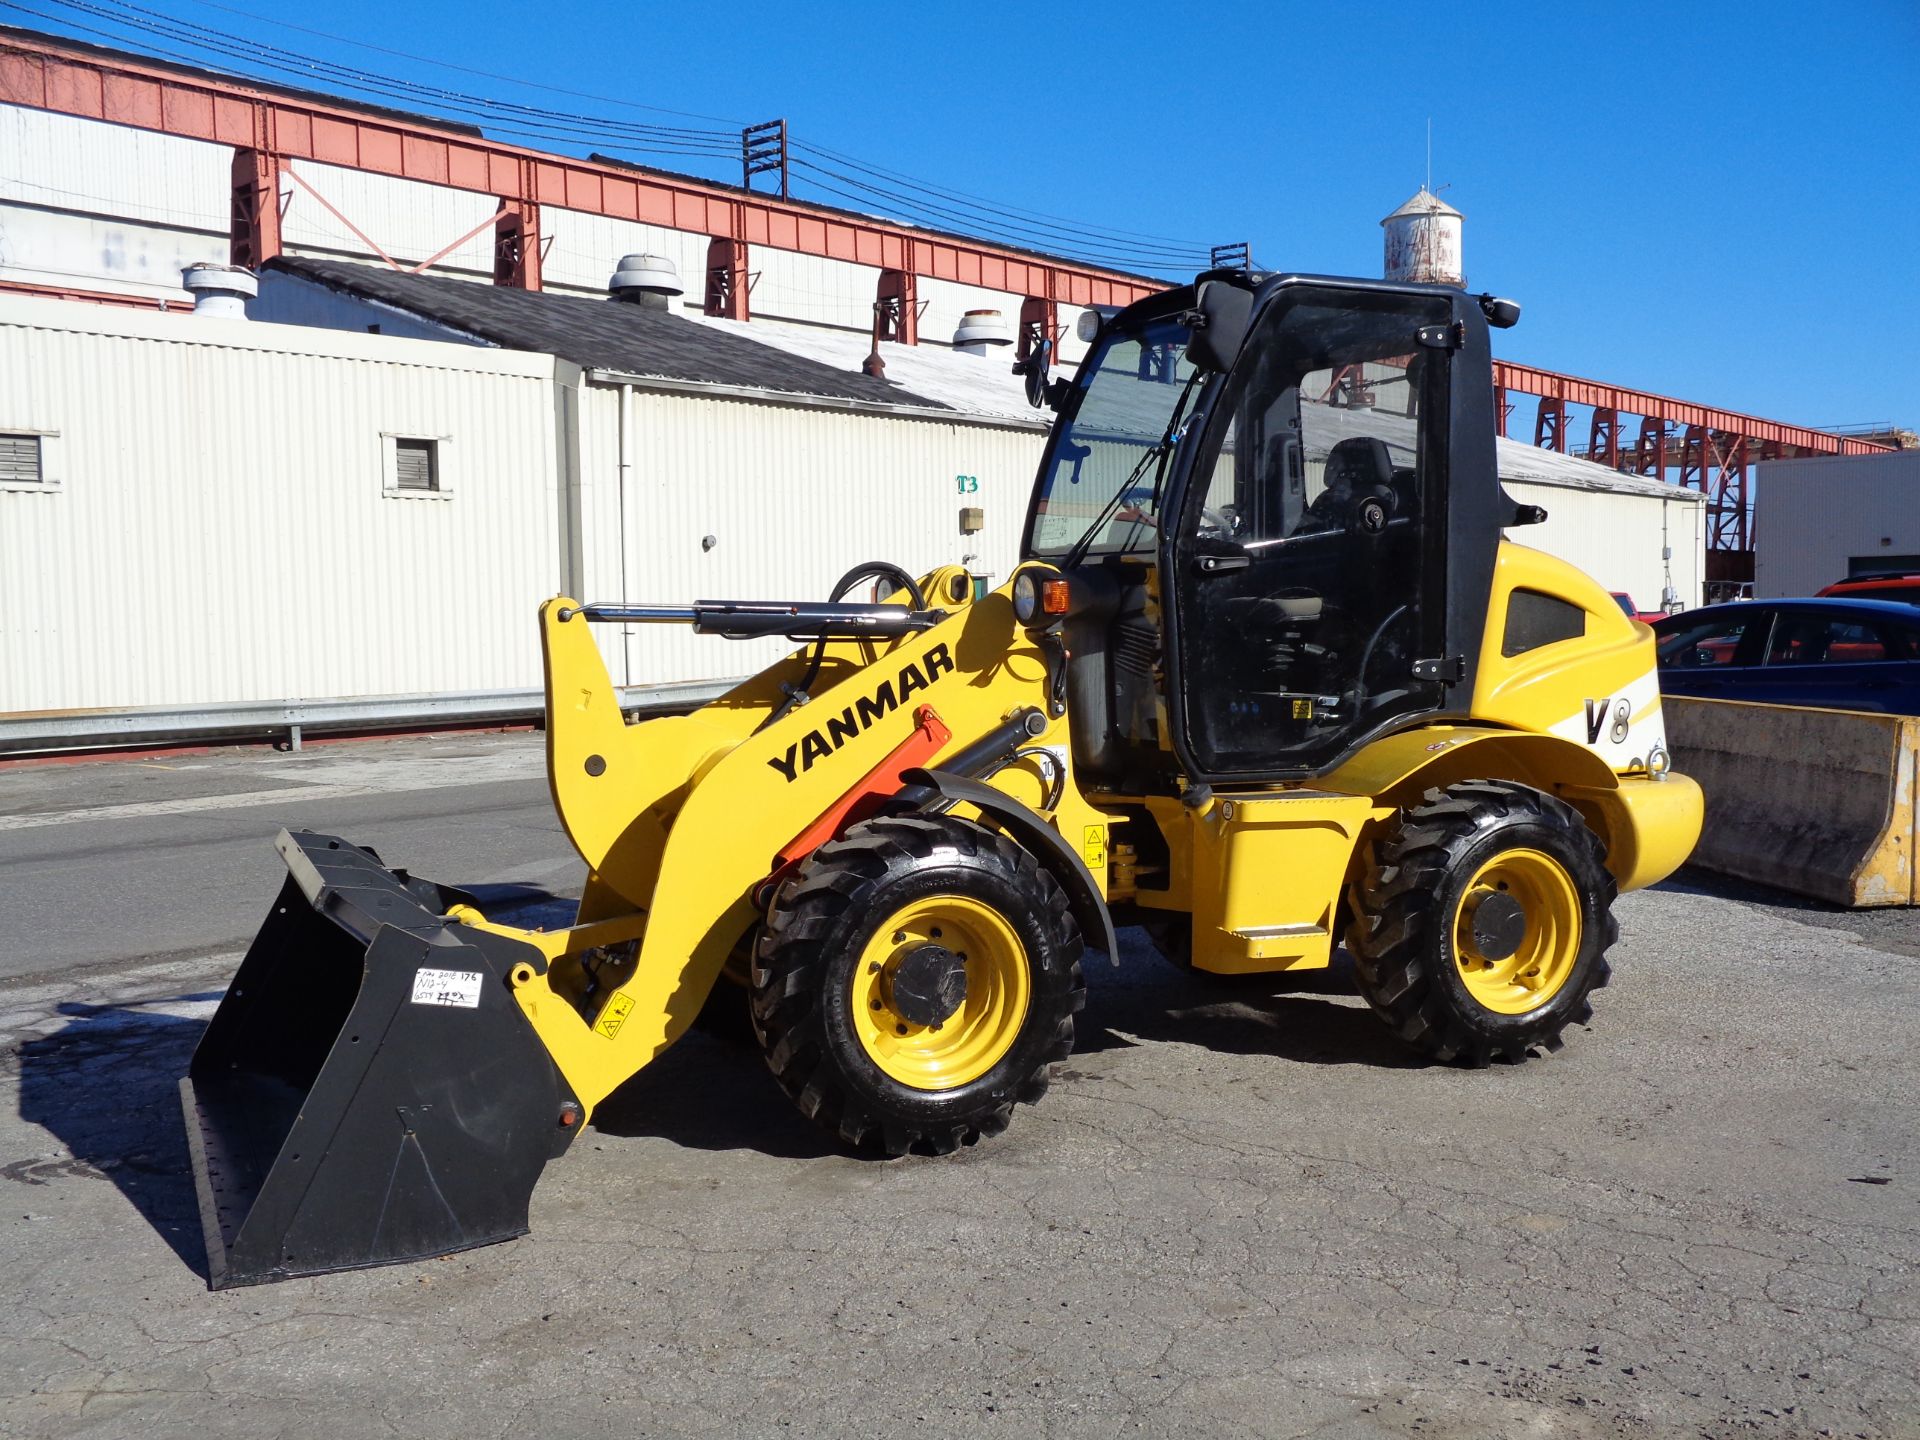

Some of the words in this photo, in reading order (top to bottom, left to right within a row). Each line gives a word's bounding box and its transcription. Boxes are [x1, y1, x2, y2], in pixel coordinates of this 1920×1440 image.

[956, 475, 978, 494] T3
[767, 642, 955, 783] YANMAR
[461, 973, 477, 982] 176
